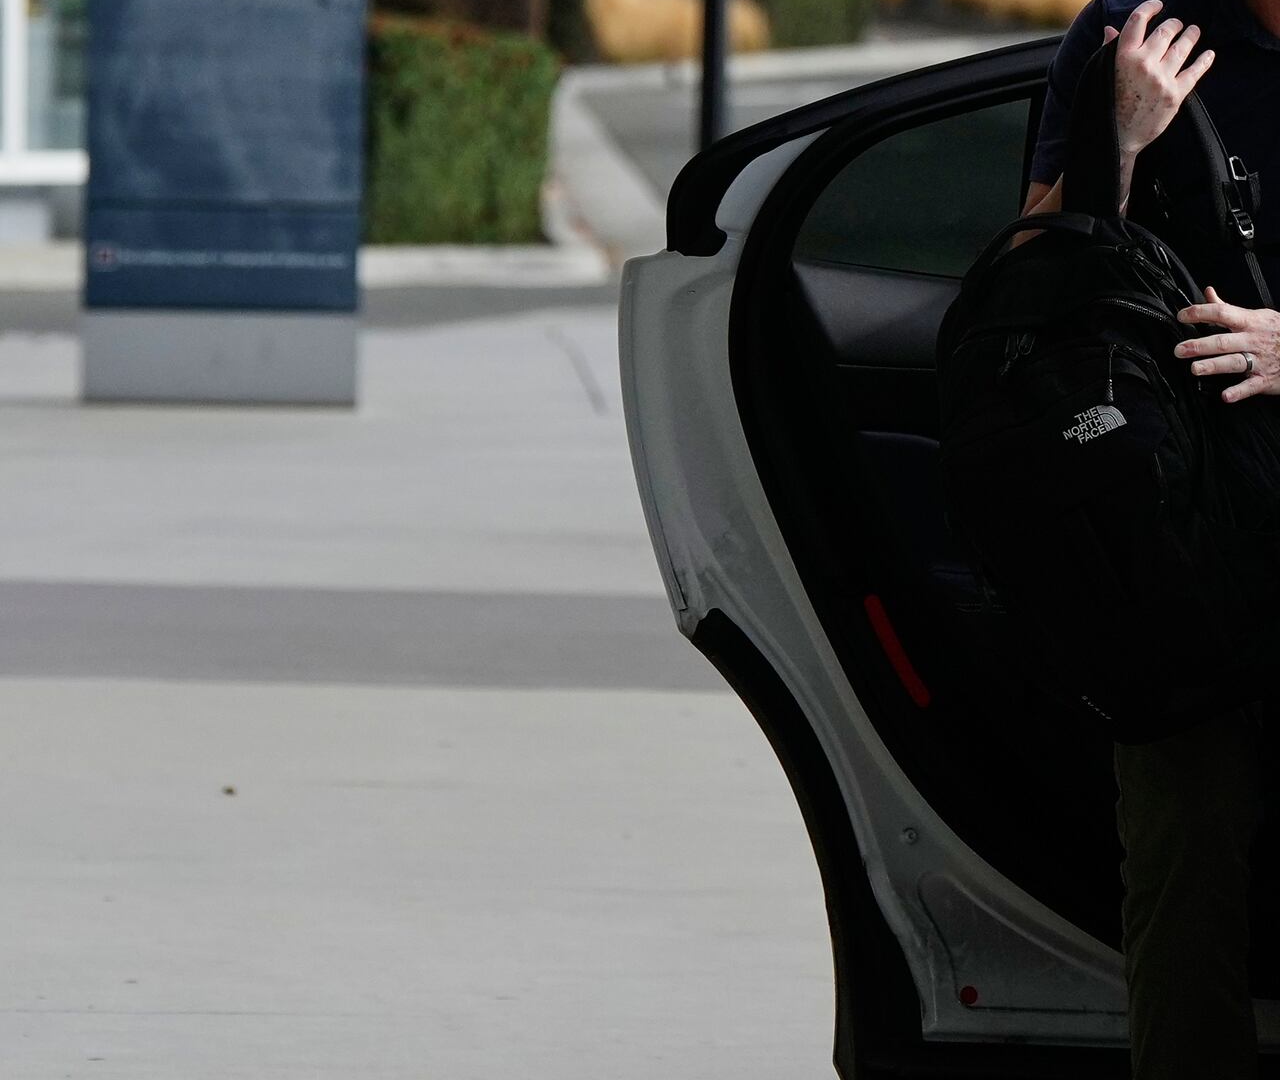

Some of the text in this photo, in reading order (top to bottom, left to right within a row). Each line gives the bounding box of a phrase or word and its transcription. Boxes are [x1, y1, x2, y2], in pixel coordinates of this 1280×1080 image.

[1073, 406, 1099, 423] THE
[1062, 415, 1103, 440] NORTH
[1077, 424, 1107, 444] FACE
